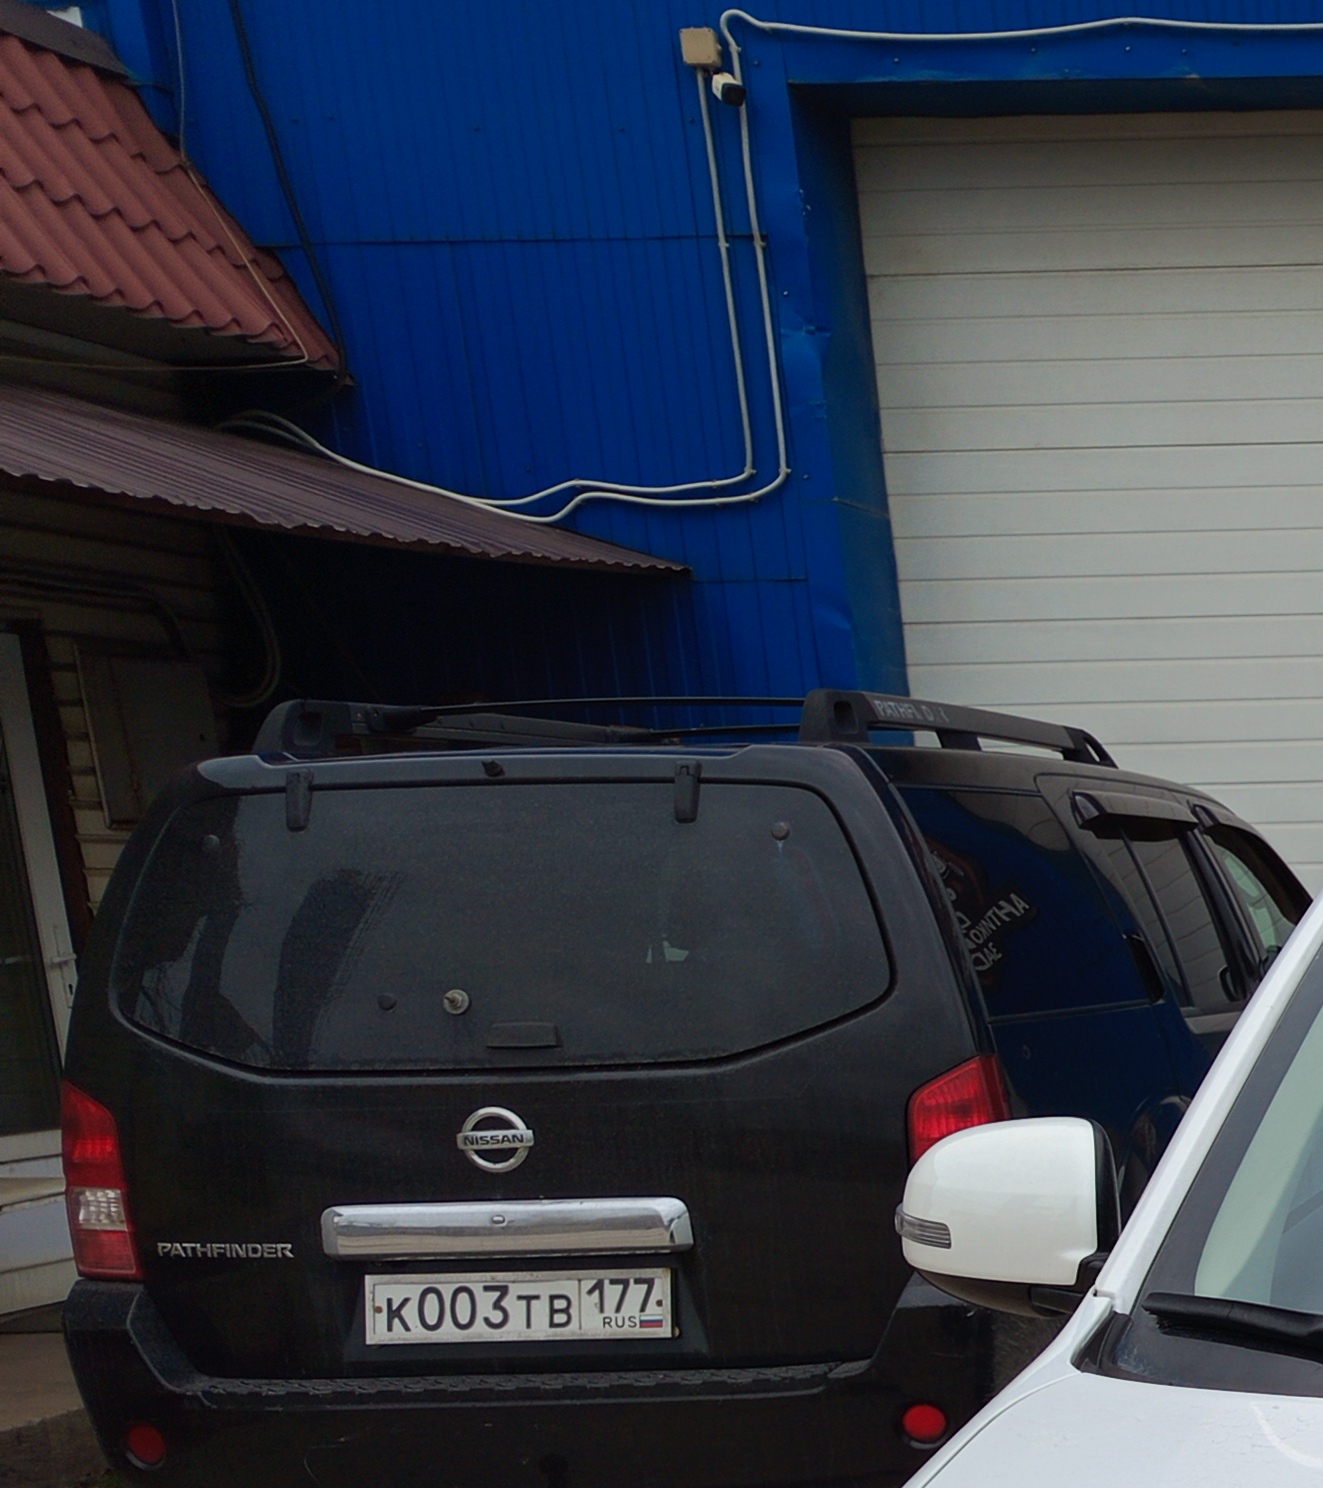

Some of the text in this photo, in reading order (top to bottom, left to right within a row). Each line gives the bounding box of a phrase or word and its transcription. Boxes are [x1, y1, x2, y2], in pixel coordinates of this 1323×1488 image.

[463, 1133, 524, 1147] NISSAN
[157, 1242, 295, 1258] PATHFINDER
[586, 1277, 656, 1314] 177
[602, 1315, 638, 1329] RUS
